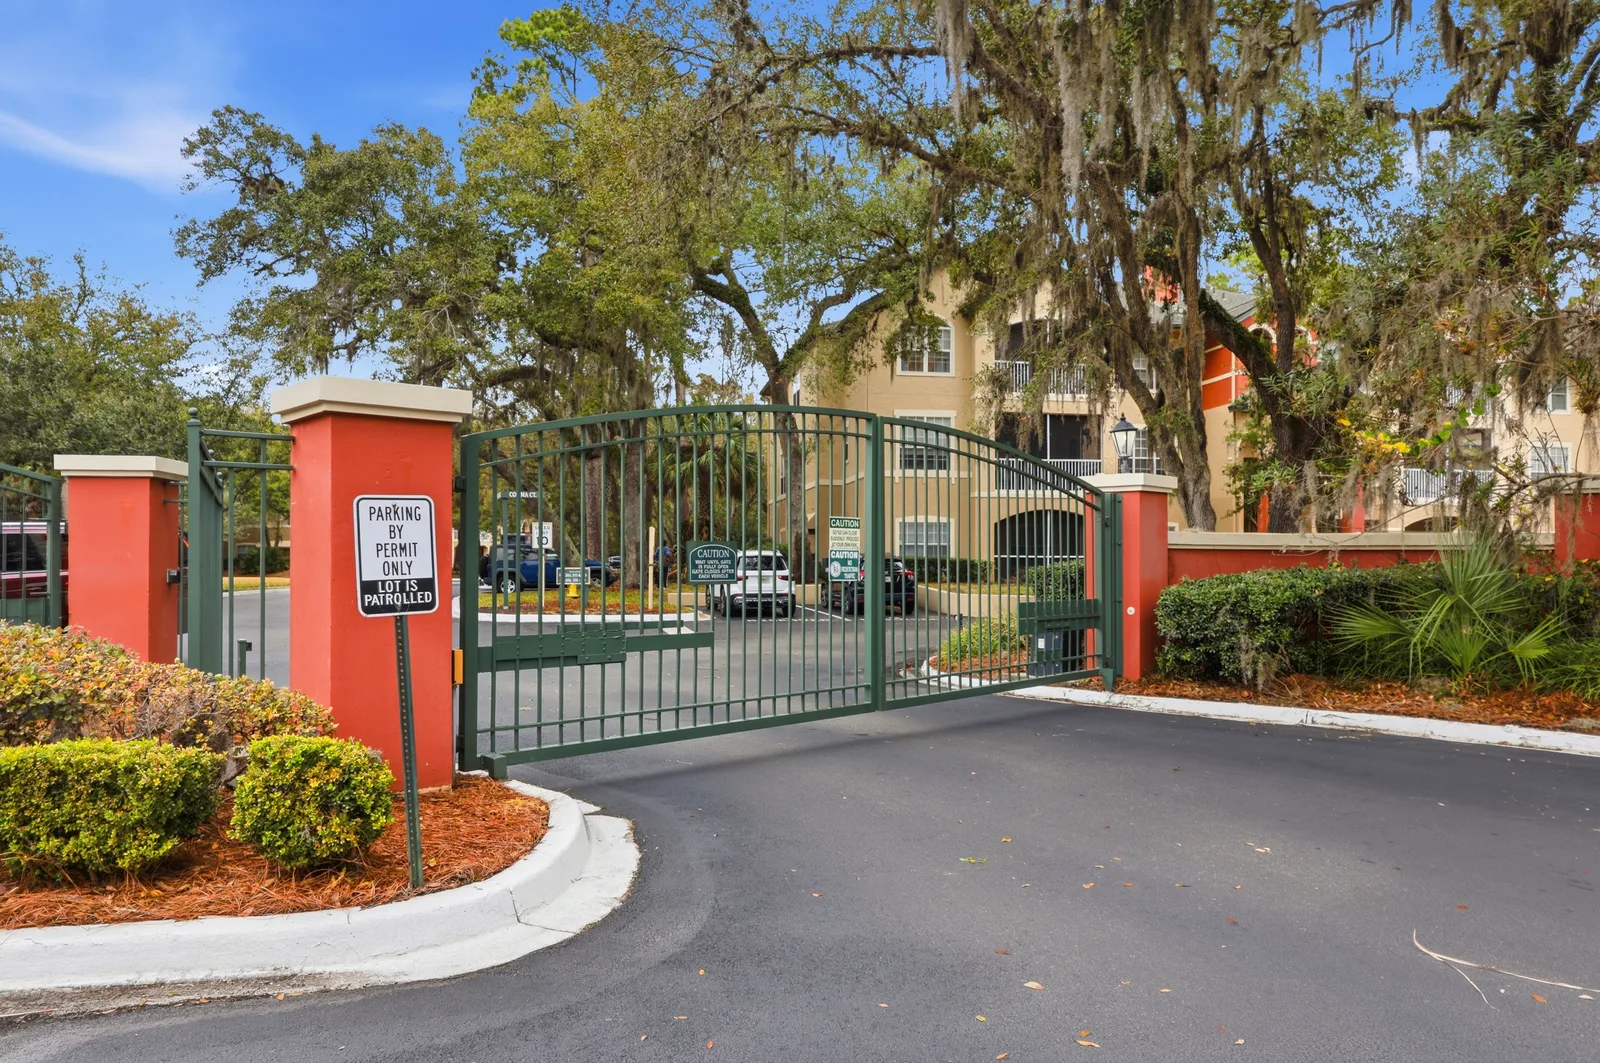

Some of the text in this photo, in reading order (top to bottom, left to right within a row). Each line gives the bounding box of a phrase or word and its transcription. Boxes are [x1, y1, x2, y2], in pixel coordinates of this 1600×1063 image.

[369, 506, 421, 521] PARKING
[831, 518, 859, 528] CAUTION
[389, 524, 404, 540] BY
[376, 542, 418, 558] PERMIT
[697, 549, 730, 558] CAUTION
[831, 551, 858, 559] CAUTION
[382, 560, 413, 576] ONLY
[378, 580, 419, 593] LOT IS
[364, 592, 432, 606] PATROLLED
